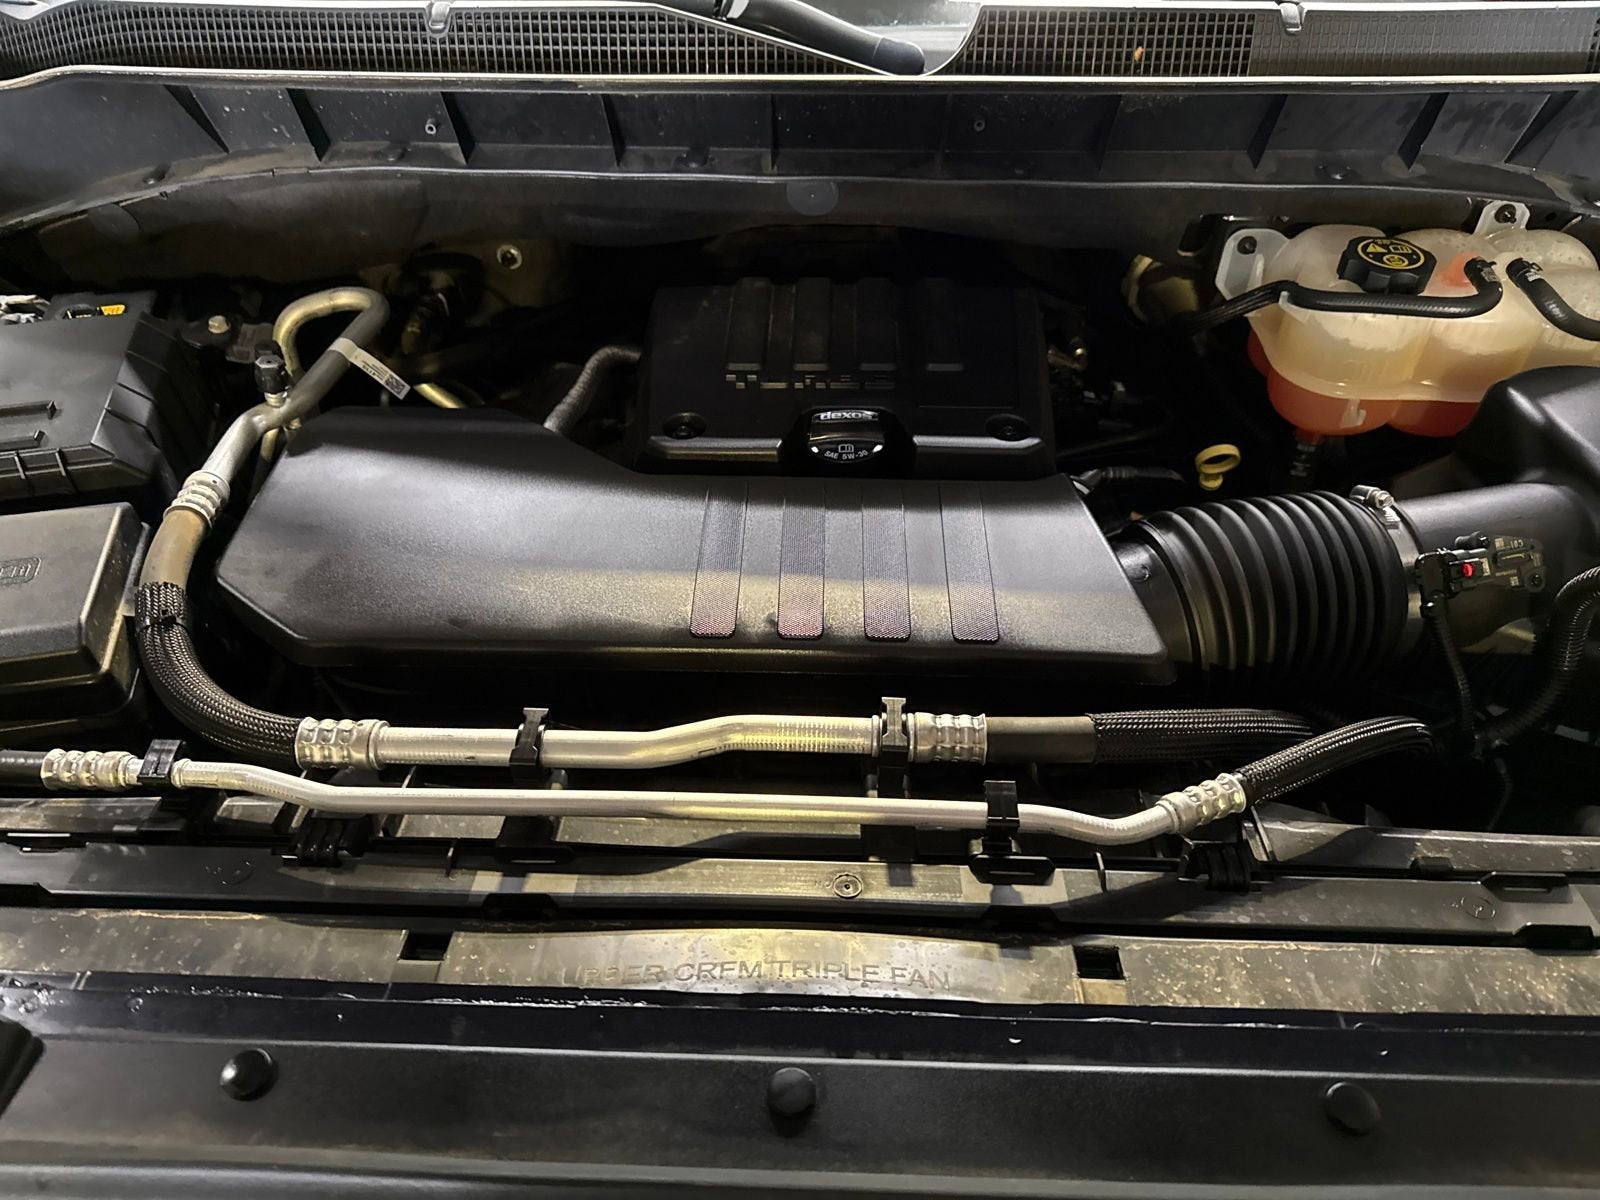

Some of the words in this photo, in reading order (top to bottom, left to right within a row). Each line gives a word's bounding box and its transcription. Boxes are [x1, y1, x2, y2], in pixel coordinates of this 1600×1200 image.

[824, 450, 839, 459] SAE
[842, 450, 868, 460] 5W-30
[772, 961, 881, 983] TRIPLE
[891, 966, 951, 991] FAN
